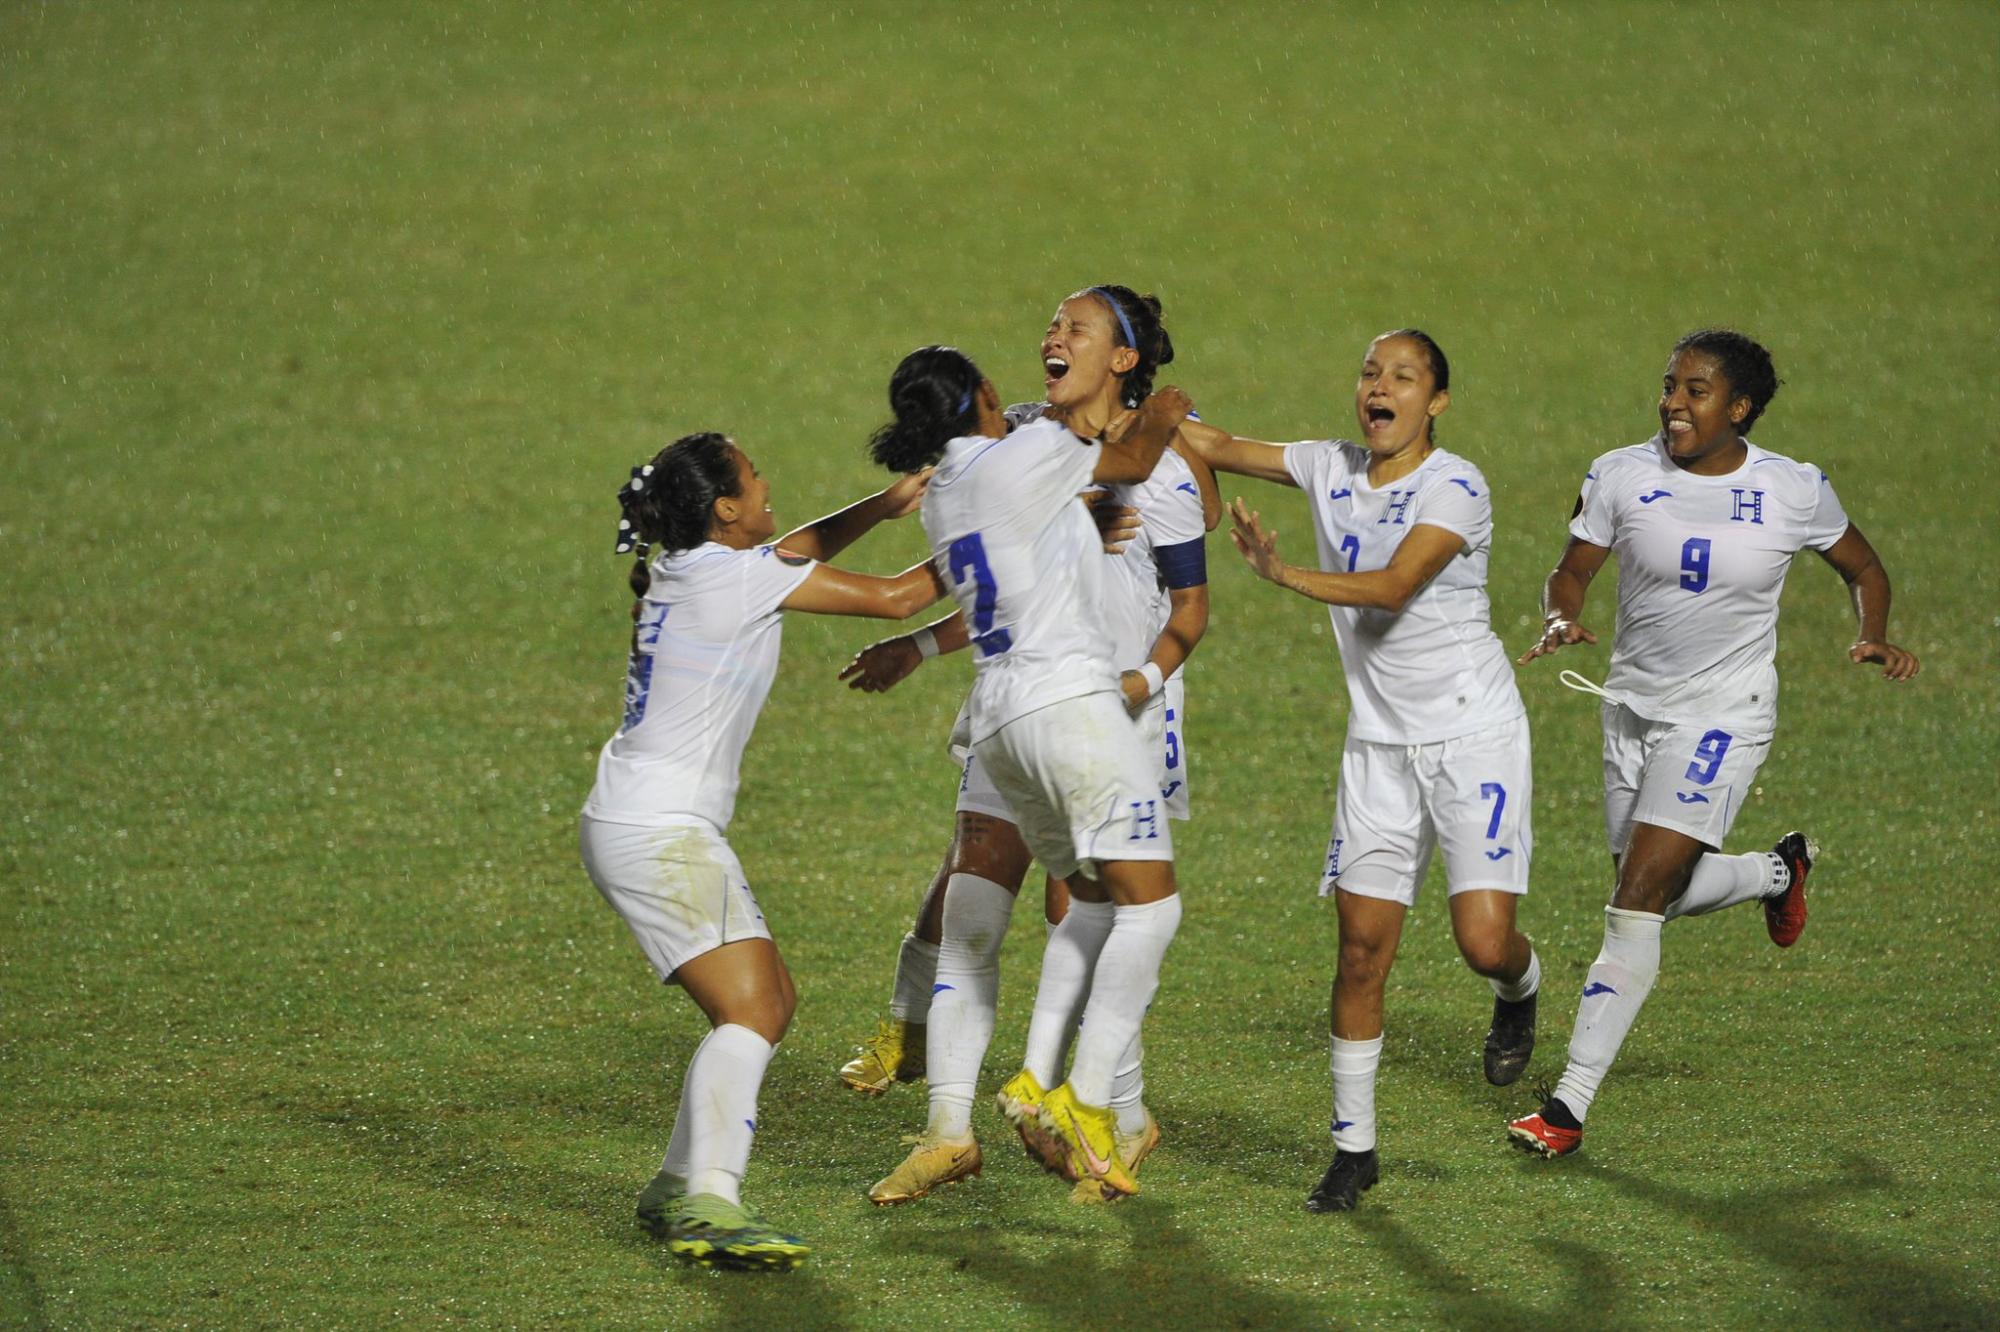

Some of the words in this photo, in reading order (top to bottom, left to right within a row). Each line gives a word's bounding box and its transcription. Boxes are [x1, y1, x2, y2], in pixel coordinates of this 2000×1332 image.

[1378, 491, 1416, 525] H
[1731, 488, 1765, 525] H
[1340, 534, 1360, 573] 7
[1680, 537, 1711, 594] 9
[949, 531, 1014, 658] 2
[1684, 729, 1733, 786] 9
[1480, 782, 1507, 840] 7
